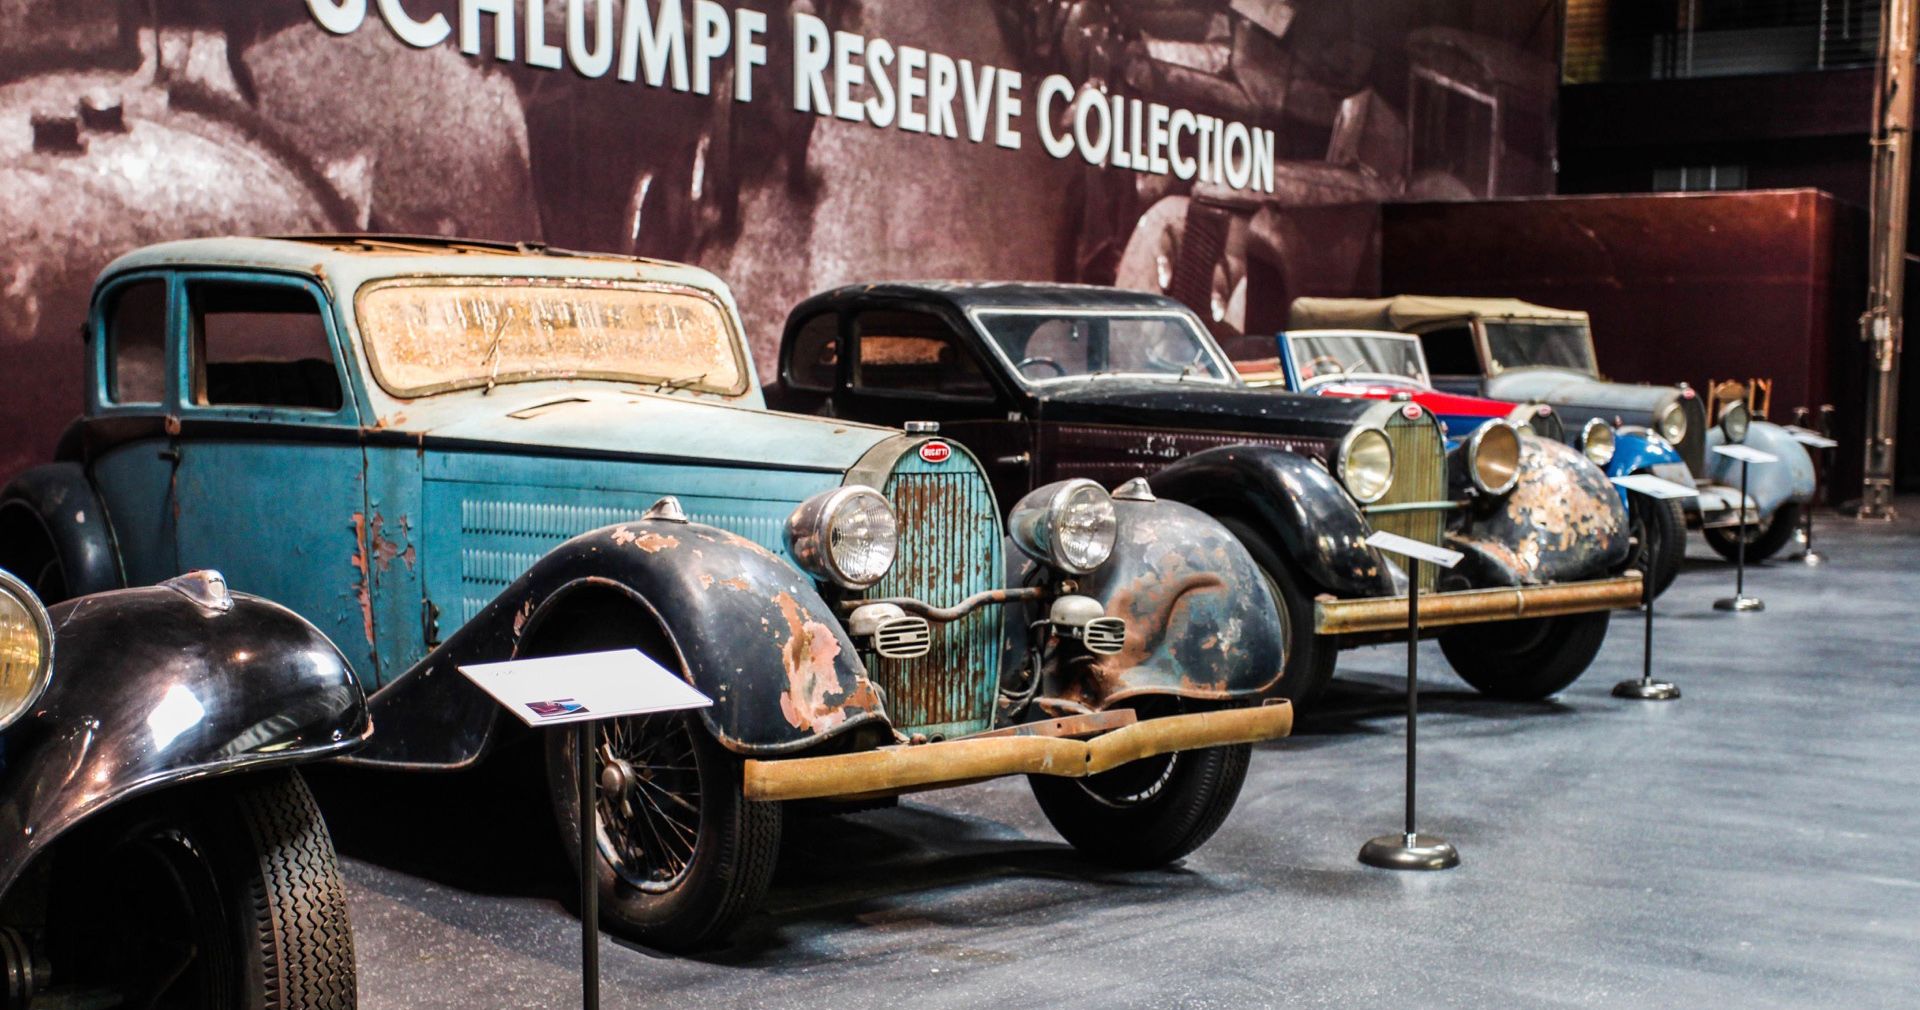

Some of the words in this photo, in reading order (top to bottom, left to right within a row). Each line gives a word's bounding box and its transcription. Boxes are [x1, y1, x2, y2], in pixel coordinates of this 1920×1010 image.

[307, 0, 767, 103] HLUMPF
[793, 12, 1022, 150] RESERVE
[1036, 74, 1275, 194] COLLECTION
